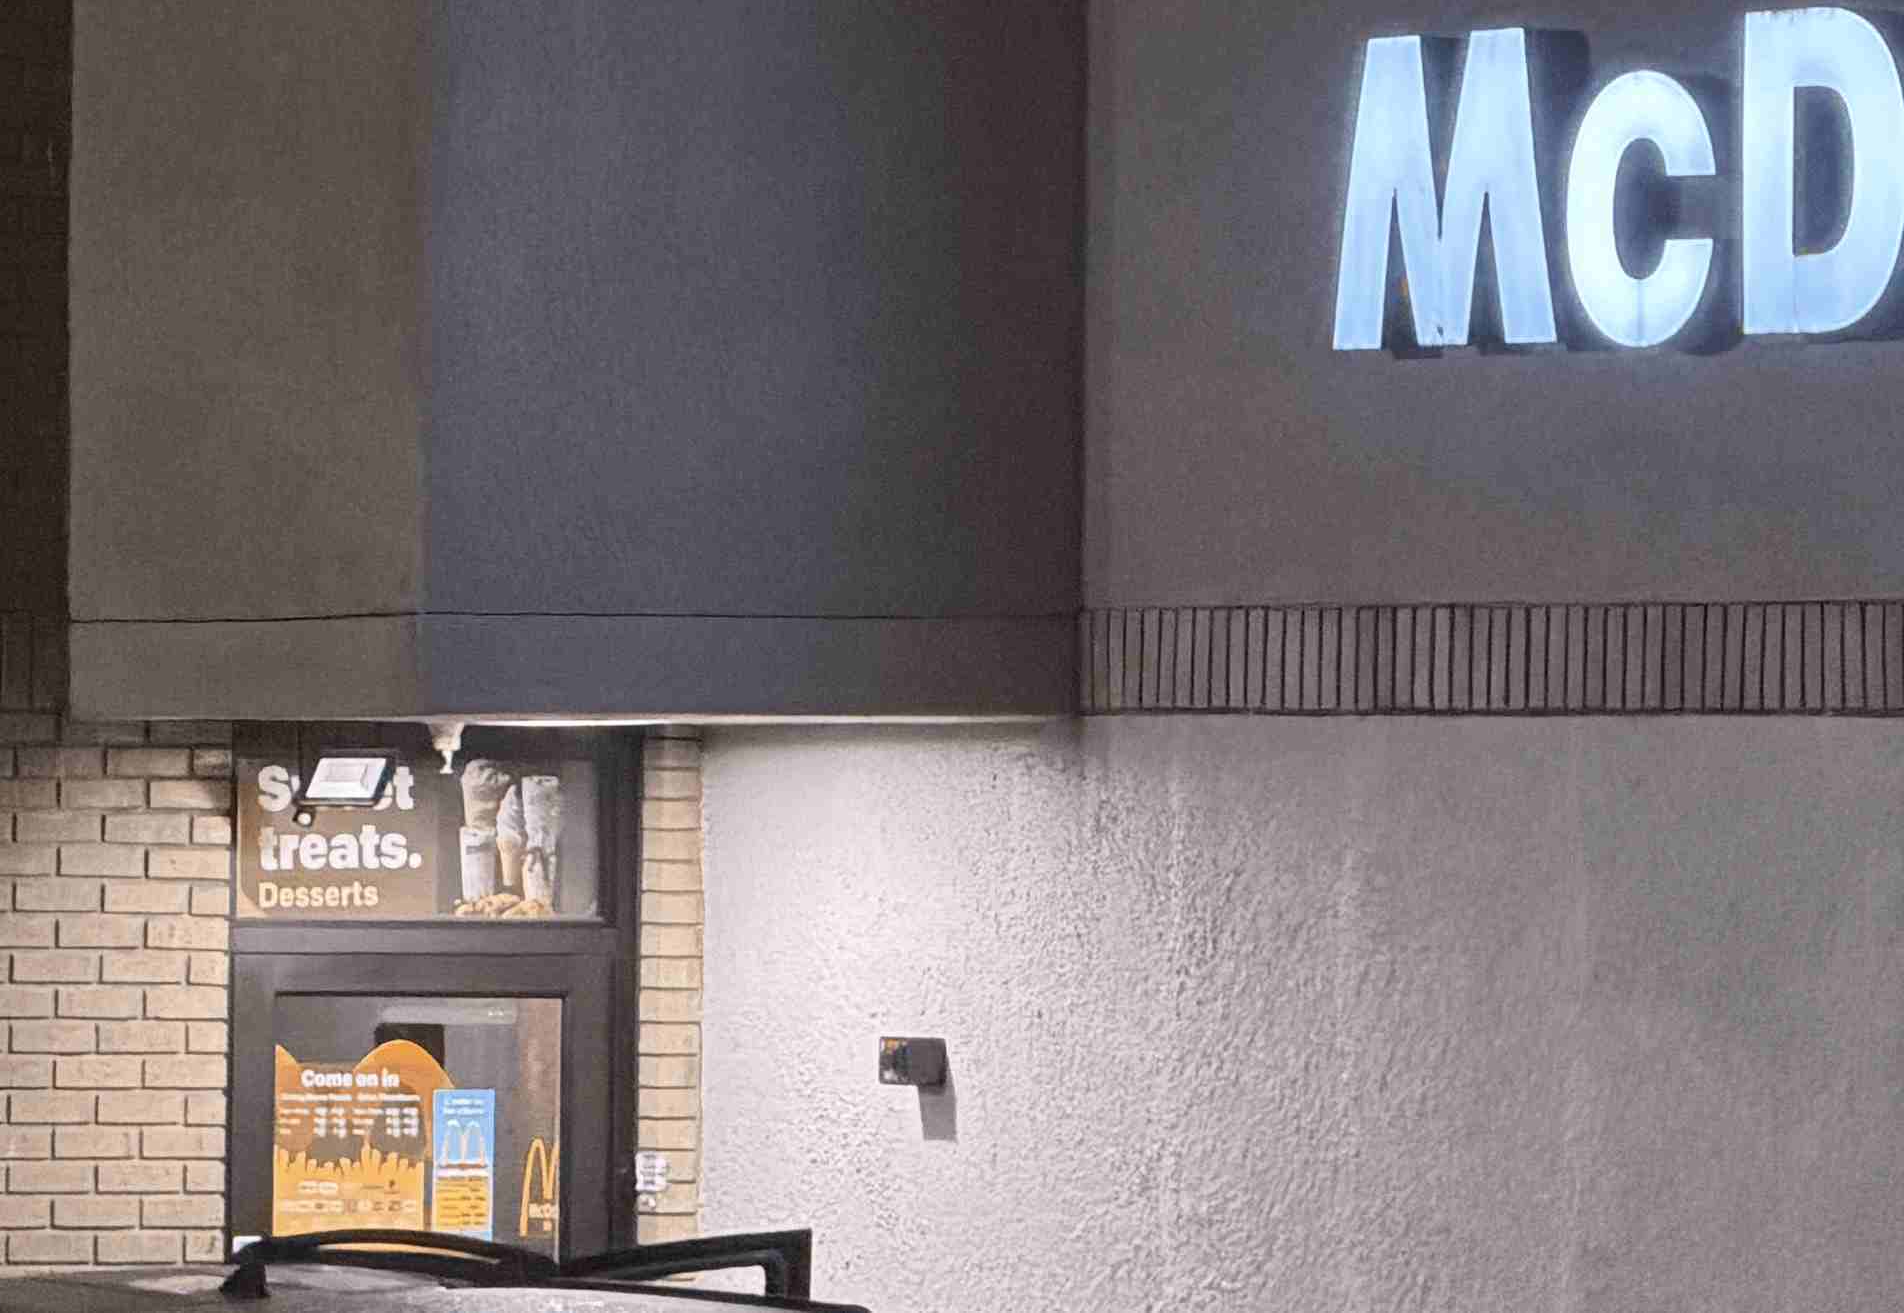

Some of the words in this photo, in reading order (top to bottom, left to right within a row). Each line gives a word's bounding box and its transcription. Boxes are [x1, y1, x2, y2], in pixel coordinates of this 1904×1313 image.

[258, 824, 422, 871] treats.
[258, 881, 379, 908] Desserts
[301, 1069, 353, 1087] Come
[355, 1073, 379, 1087] on
